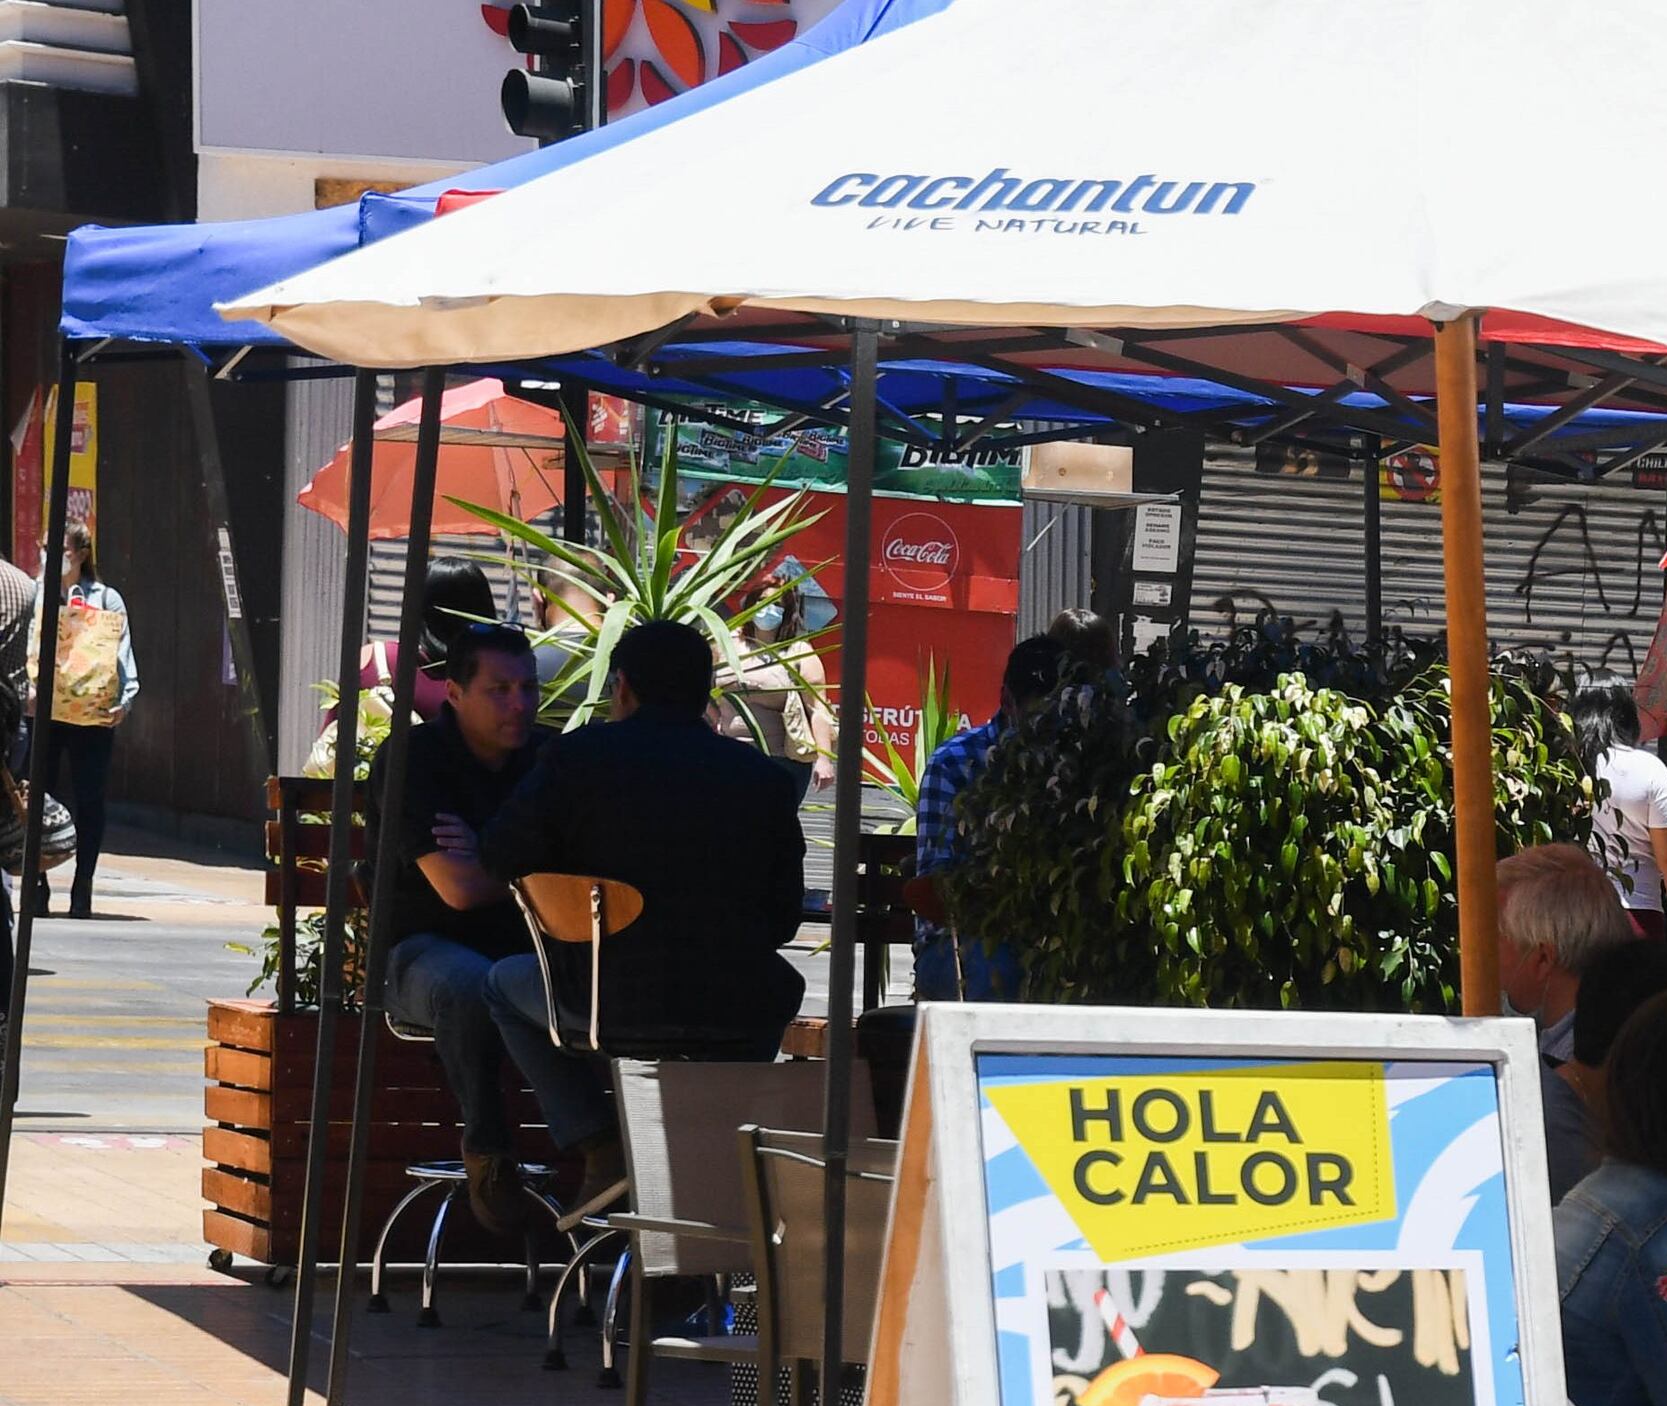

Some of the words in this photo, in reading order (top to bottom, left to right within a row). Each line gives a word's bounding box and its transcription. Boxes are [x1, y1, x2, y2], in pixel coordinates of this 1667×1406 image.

[809, 168, 1257, 216] cachantun
[975, 218, 1149, 237] NATURAL
[1069, 1087, 1304, 1144] HOLA
[1073, 1149, 1357, 1206] CALOR
